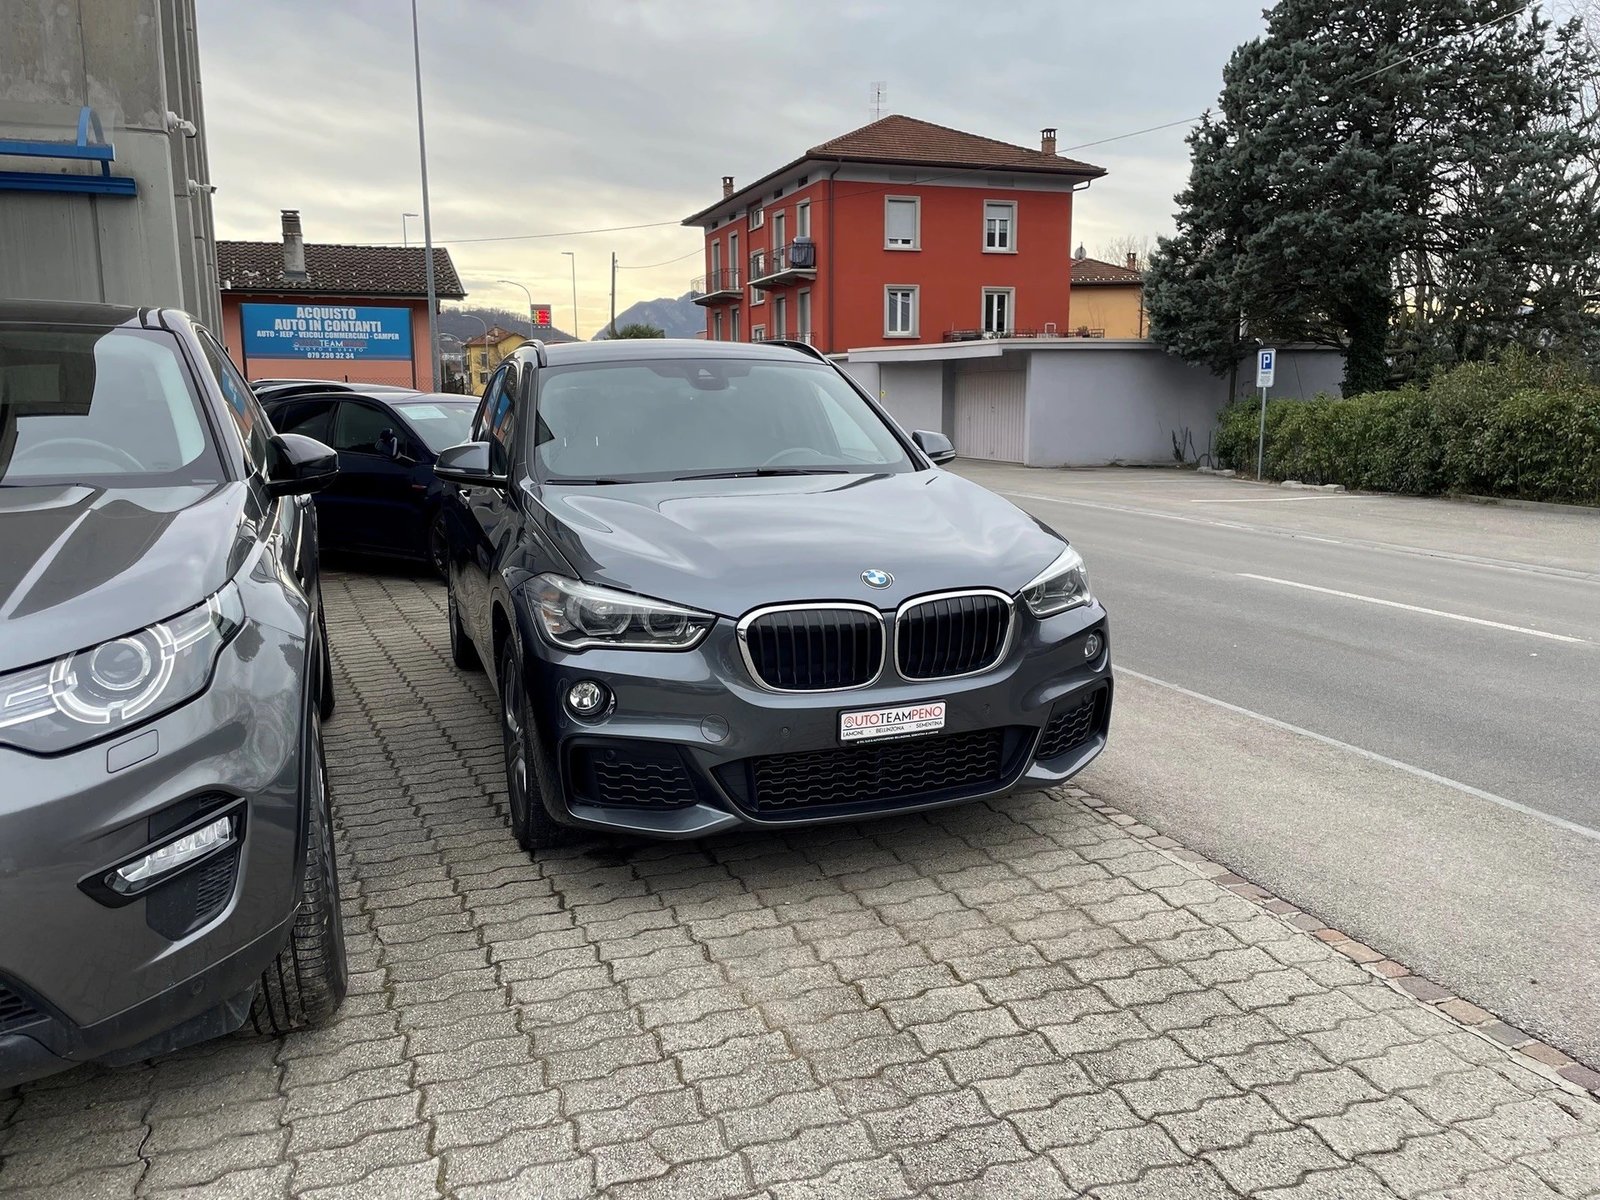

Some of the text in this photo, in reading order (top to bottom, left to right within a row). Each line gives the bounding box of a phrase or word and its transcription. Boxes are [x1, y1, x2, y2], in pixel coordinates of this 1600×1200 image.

[296, 307, 357, 320] ACQUISTO
[275, 319, 382, 333] AUTO IN CONTANTI
[256, 330, 275, 338] AUTO
[298, 331, 324, 339] VEICOLI
[324, 332, 370, 340] COMMERCIALI
[373, 333, 400, 341] CAMPER
[1263, 354, 1271, 368] P
[842, 729, 864, 738] LAMONE
[875, 725, 905, 734] BELLINZONA
[915, 720, 943, 729] SEMENTINA
